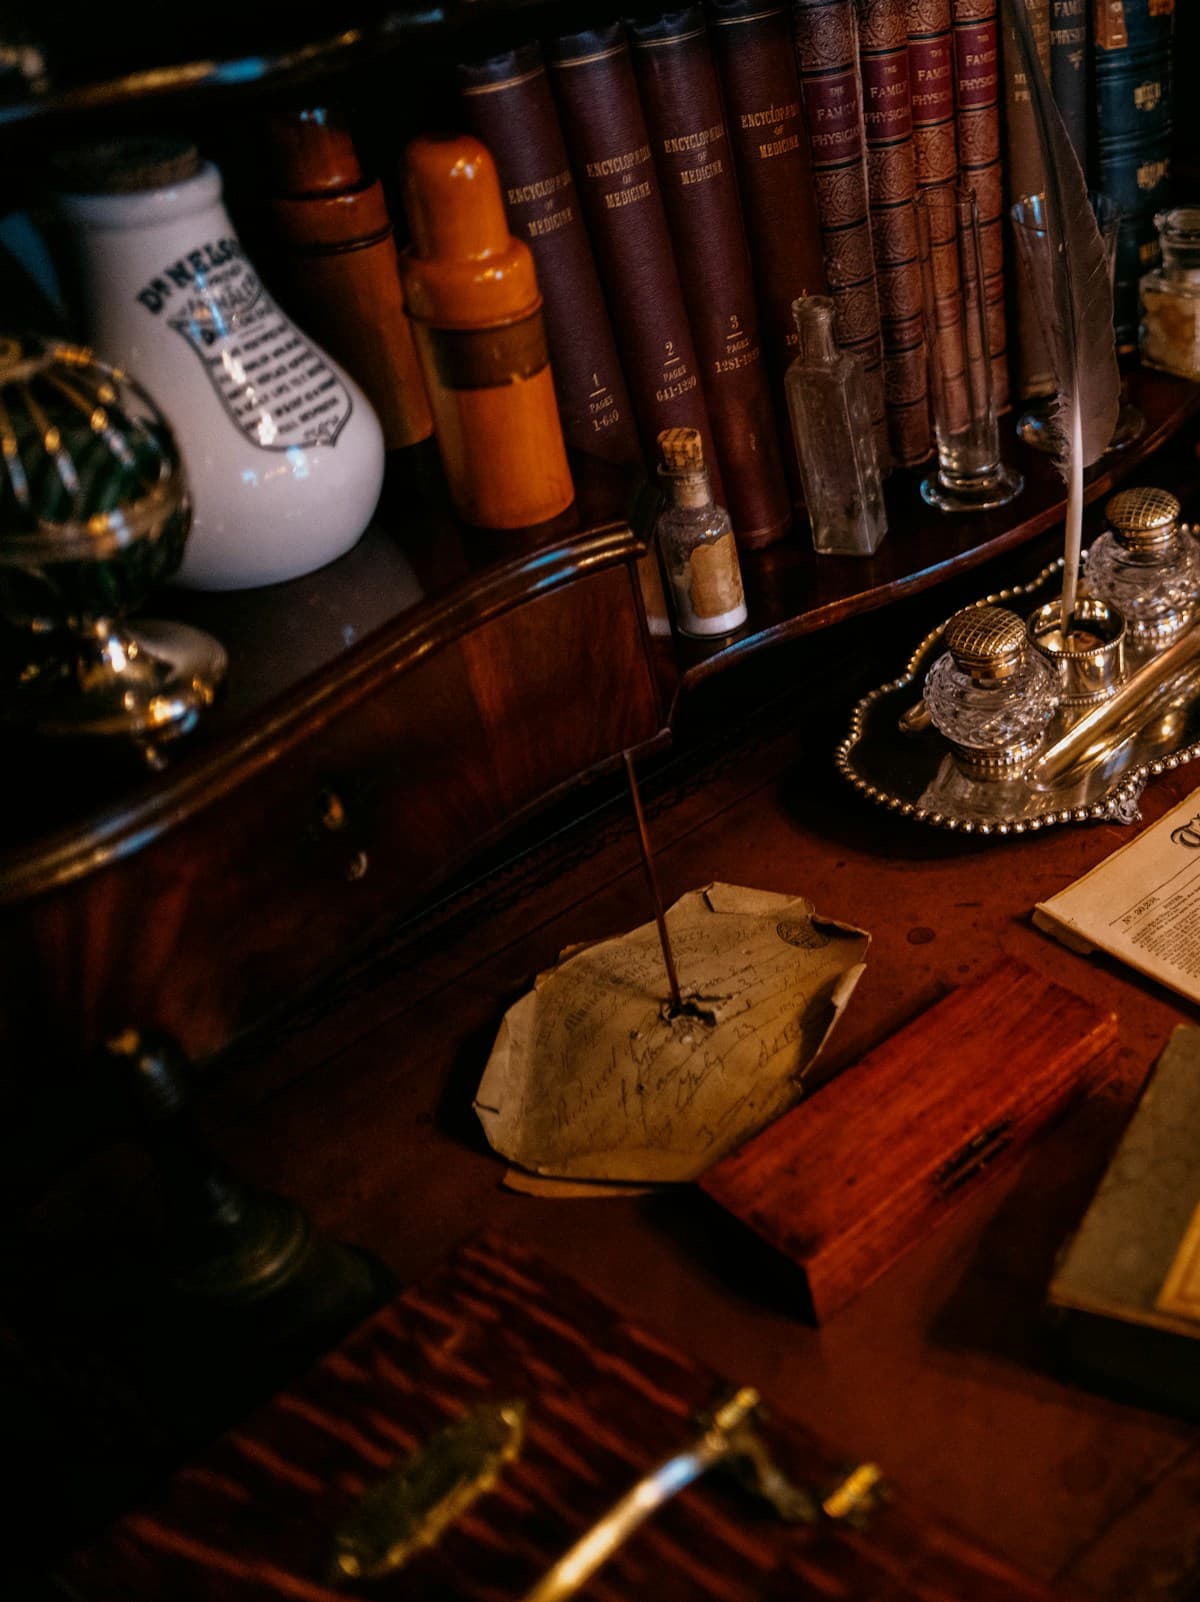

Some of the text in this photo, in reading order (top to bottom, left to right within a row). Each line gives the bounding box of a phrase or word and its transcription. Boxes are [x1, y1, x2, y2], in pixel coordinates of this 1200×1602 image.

[758, 133, 800, 160] MEDICINE
[696, 151, 709, 163] OF
[622, 173, 633, 185] OF
[679, 159, 723, 186] MEDICINE
[603, 180, 652, 210] MEDICINE
[527, 207, 575, 238] MEDICINE
[166, 239, 242, 288] NELS
[728, 313, 741, 330] 3
[664, 340, 676, 357] 2
[725, 337, 751, 355] PAGES
[591, 371, 600, 388] 1
[662, 364, 688, 383] PAGES
[588, 394, 615, 415] PAGES
